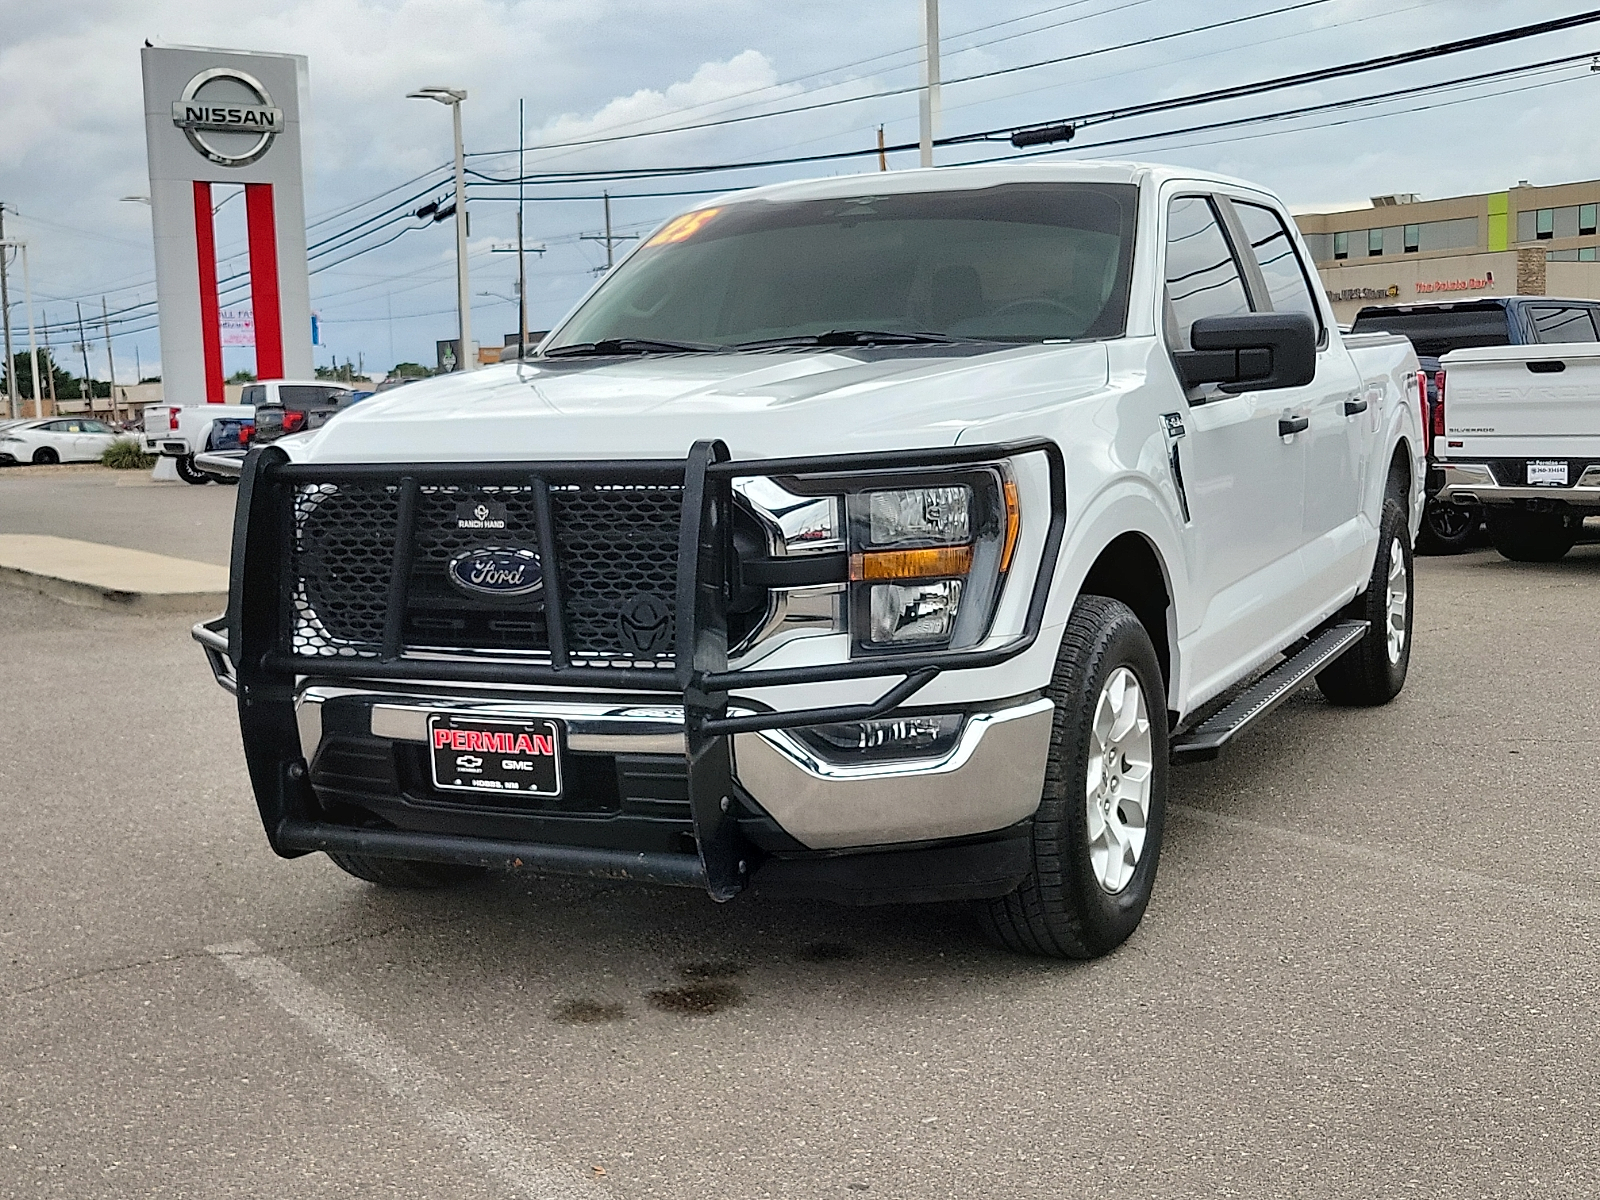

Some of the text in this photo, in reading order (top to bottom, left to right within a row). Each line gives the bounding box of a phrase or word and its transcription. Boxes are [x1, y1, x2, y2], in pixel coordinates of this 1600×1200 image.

[185, 106, 275, 126] NISSAN
[1415, 282, 1433, 293] The
[1468, 278, 1487, 289] Bar
[458, 520, 505, 529] RANCH HAND
[470, 559, 526, 585] Ford
[433, 728, 554, 756] PERMIAN
[501, 759, 534, 771] GMC
